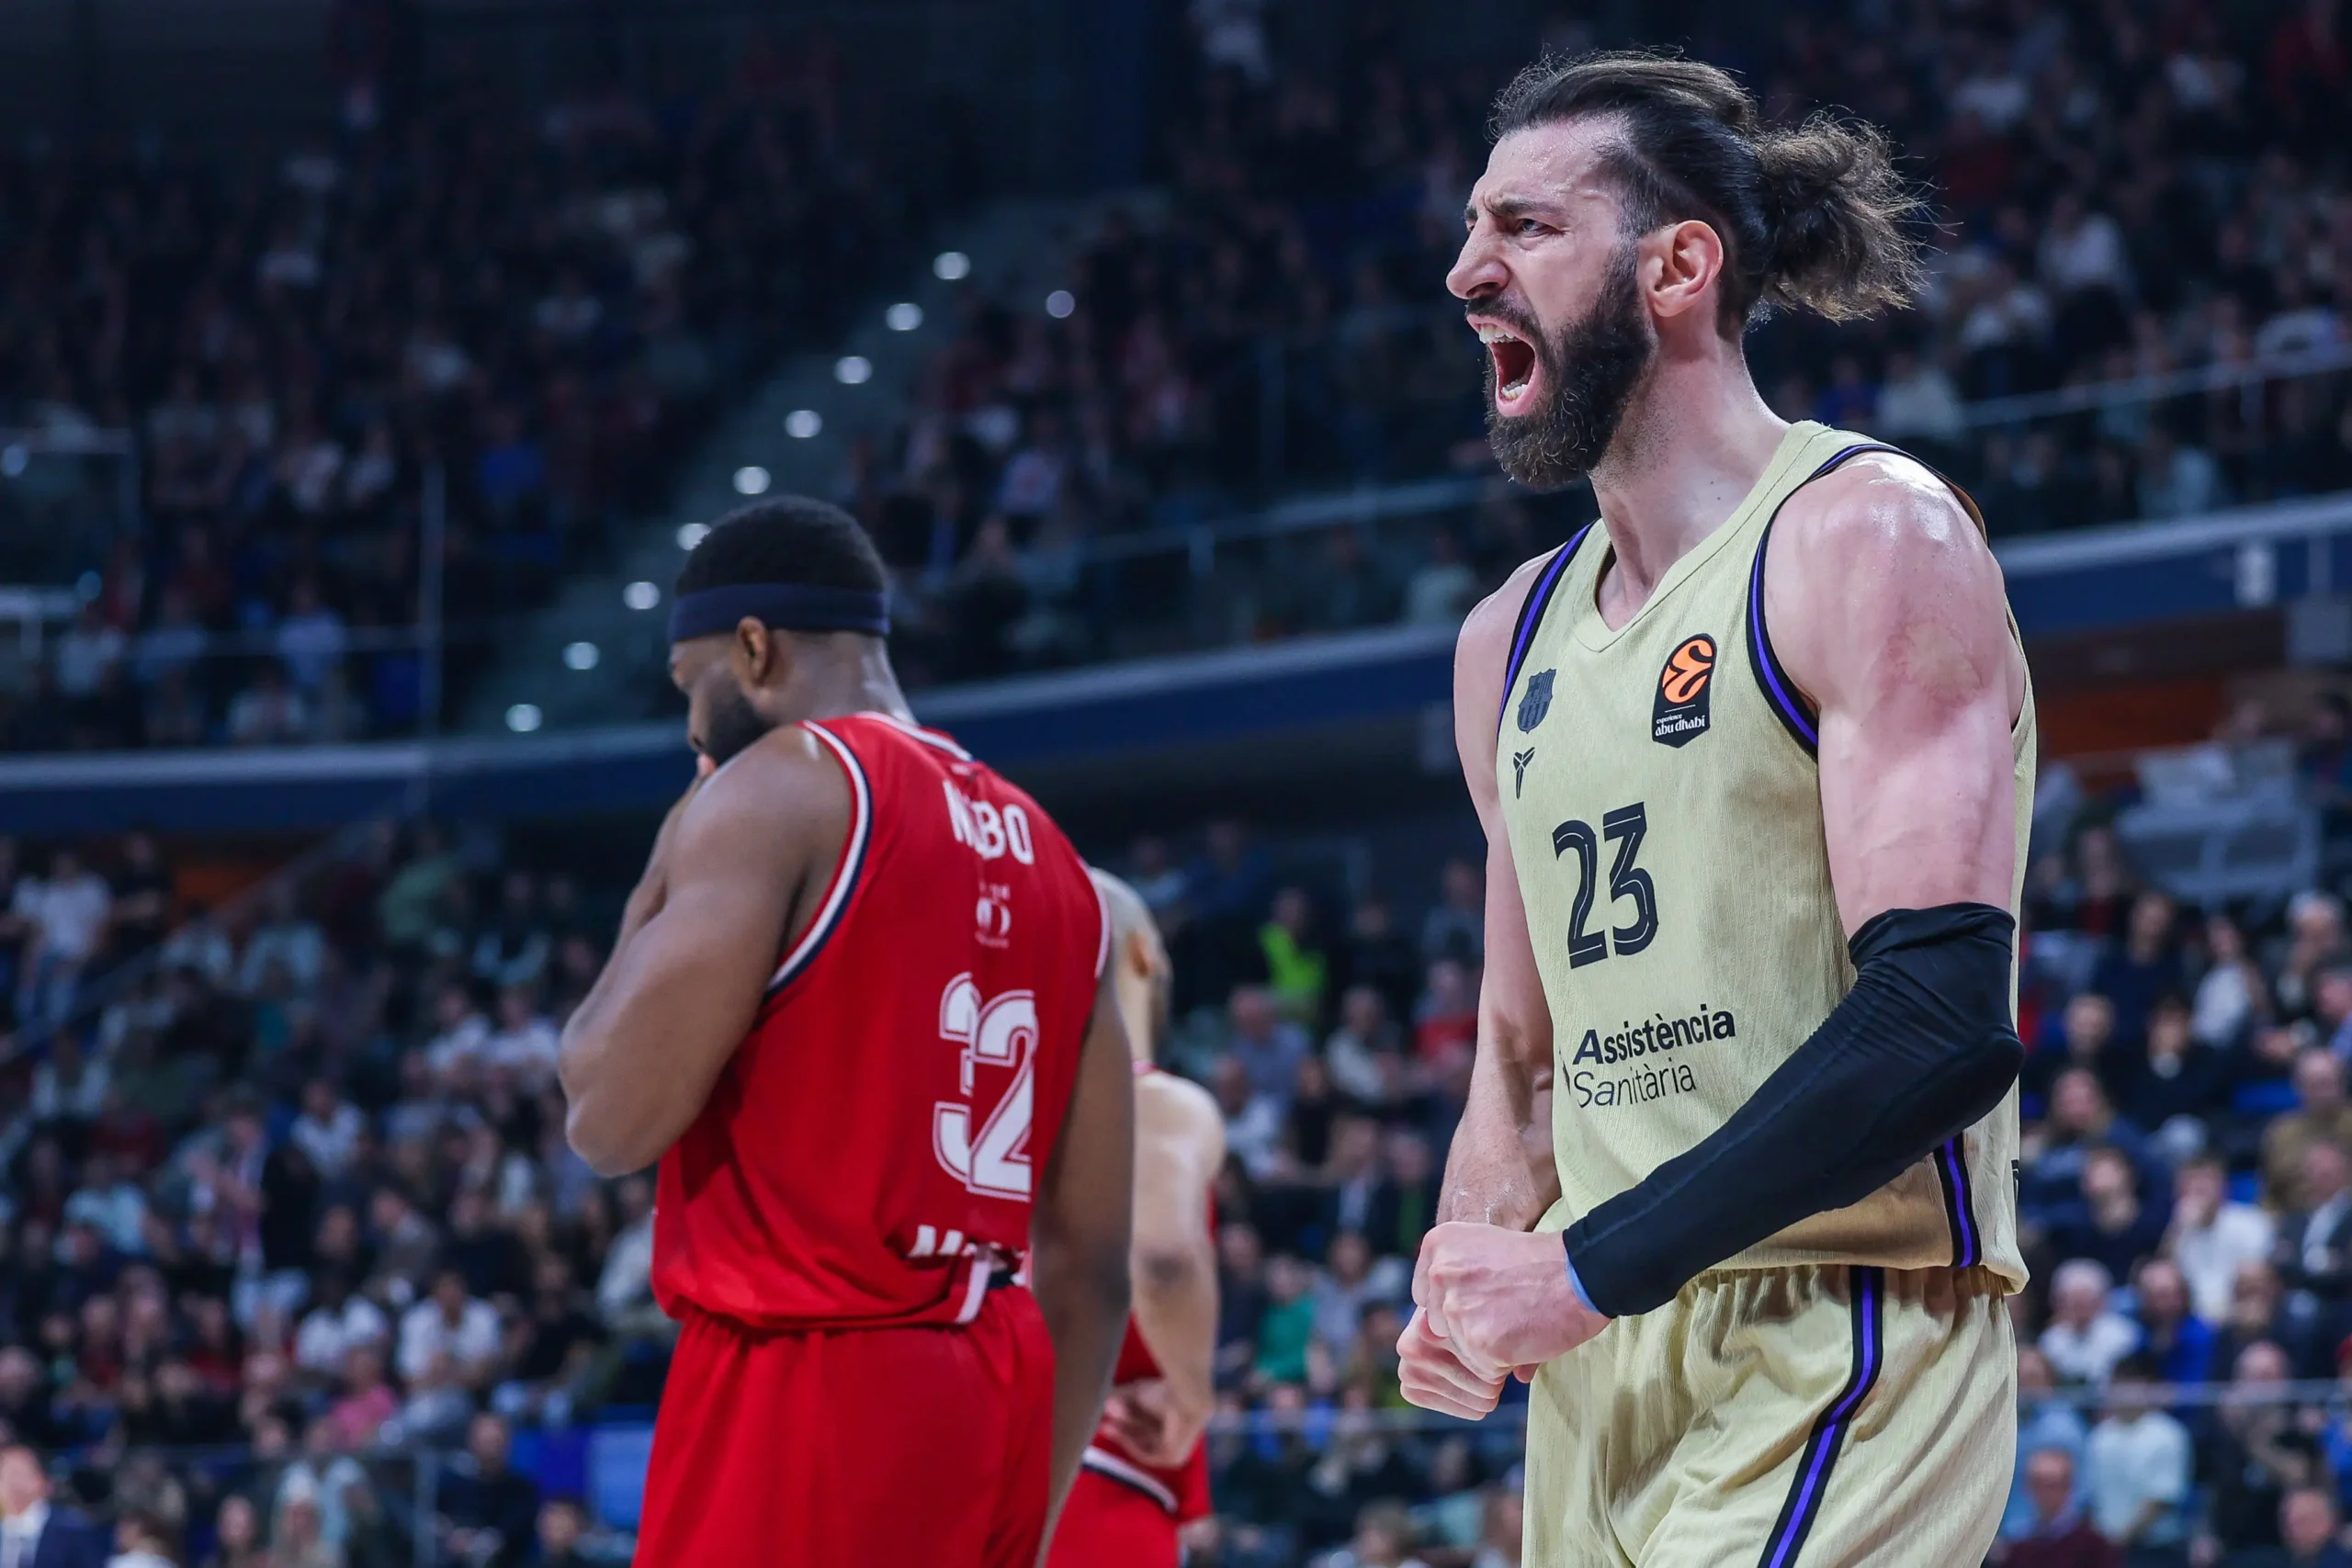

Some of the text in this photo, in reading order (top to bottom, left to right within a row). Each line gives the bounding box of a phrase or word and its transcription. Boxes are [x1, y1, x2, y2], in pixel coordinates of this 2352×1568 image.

[1655, 715, 1705, 737] abu dhabi
[1552, 801, 1659, 970] 23
[1572, 1003, 1736, 1066] Assistència
[1573, 1056, 1697, 1109] Sanitària
